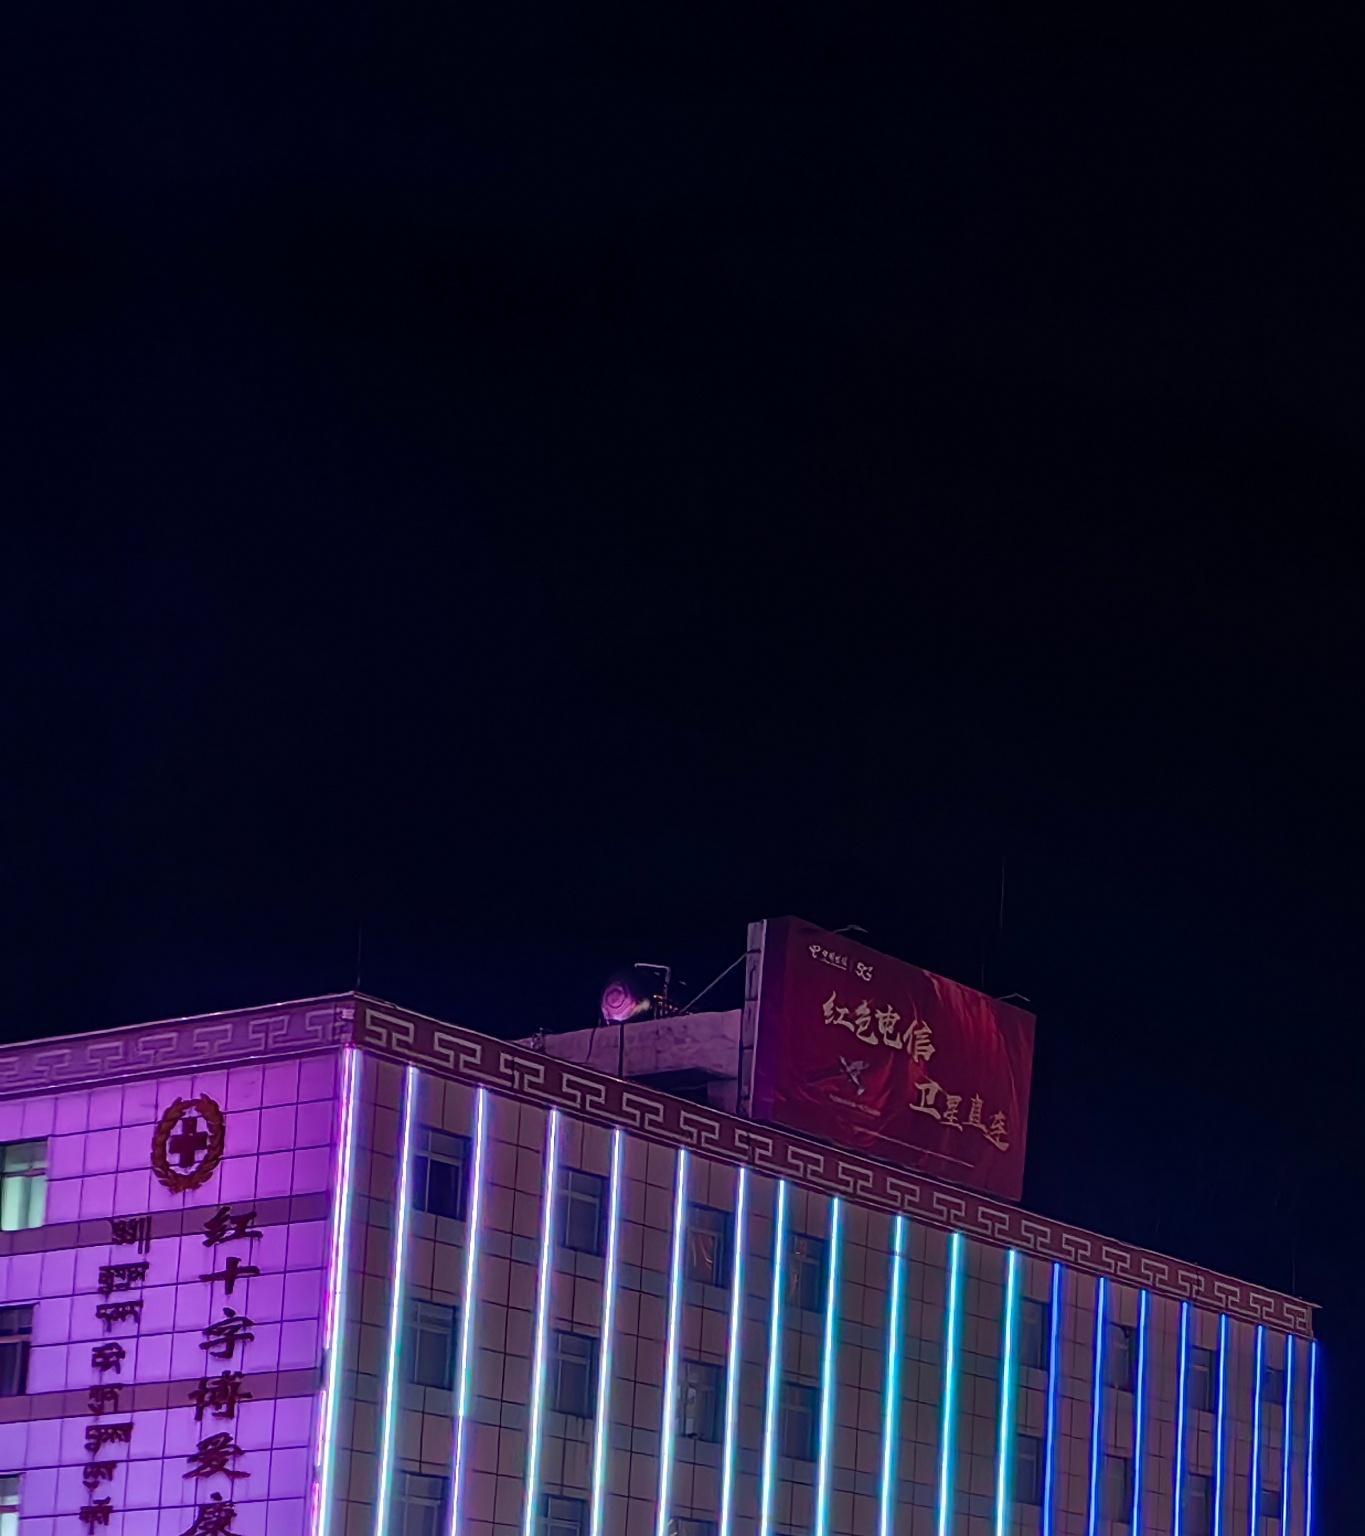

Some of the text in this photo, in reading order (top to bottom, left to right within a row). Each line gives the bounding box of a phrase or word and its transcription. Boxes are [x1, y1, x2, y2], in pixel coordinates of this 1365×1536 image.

[822, 990, 936, 1063] 红色电信
[909, 1078, 1010, 1151] 卫星直连
